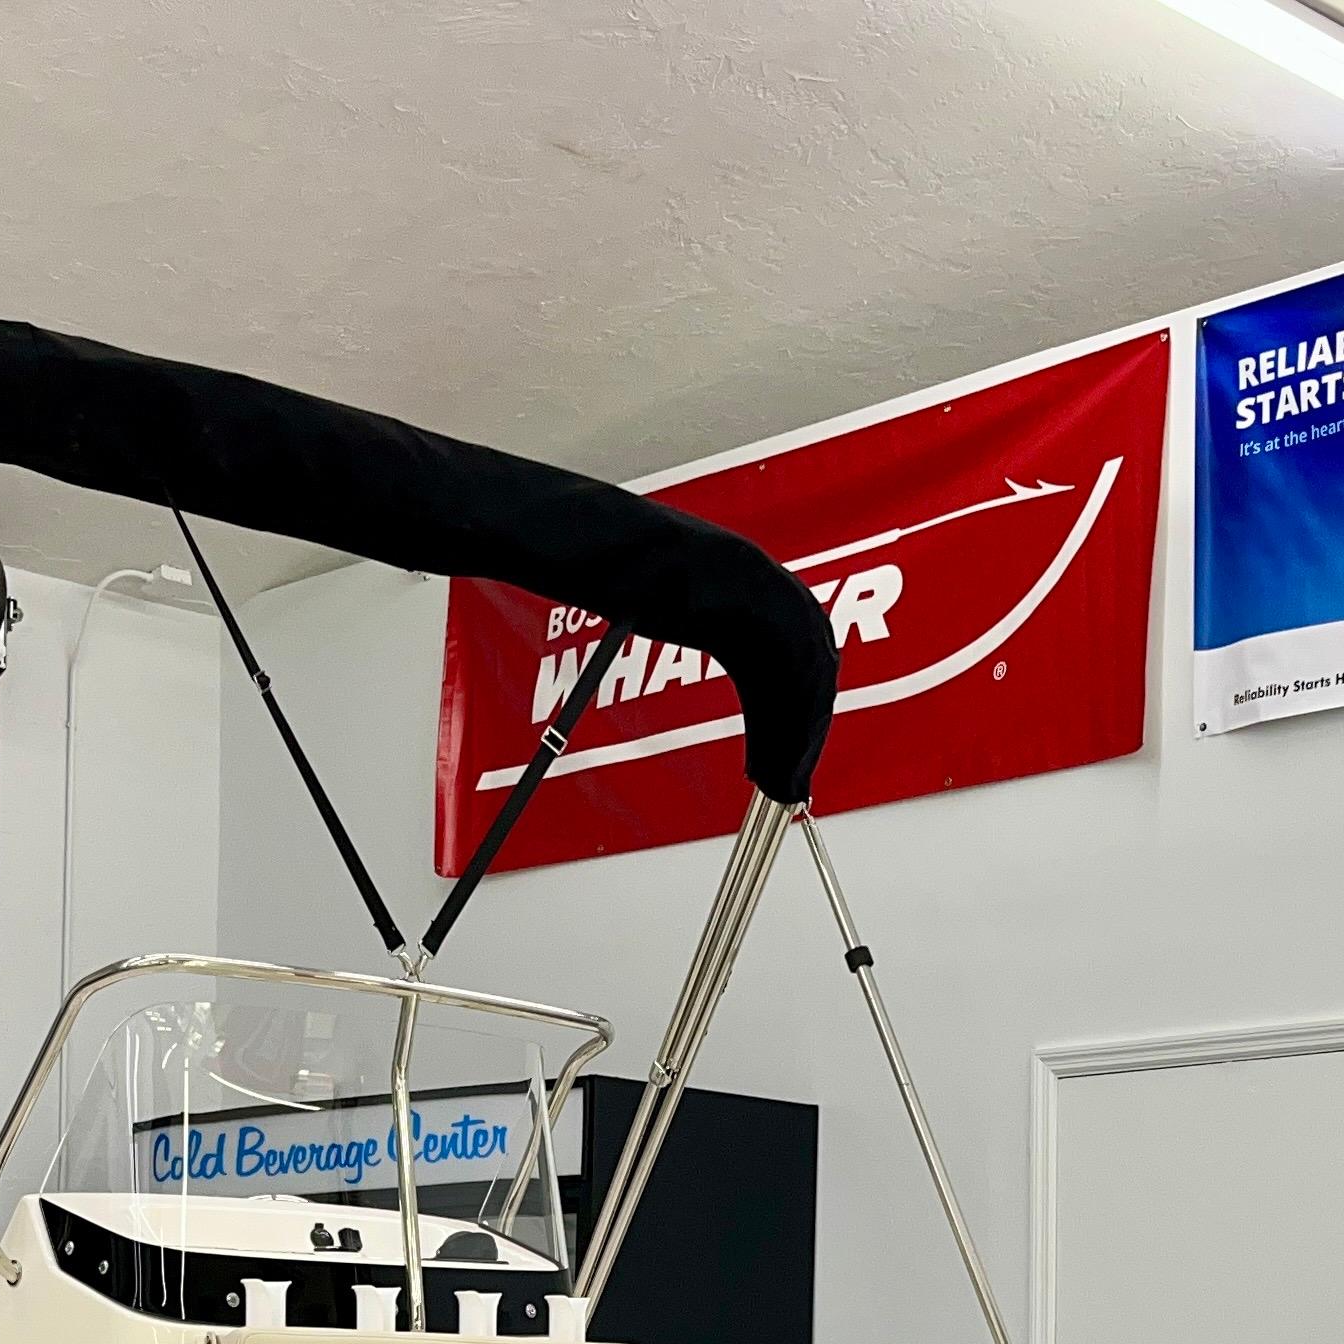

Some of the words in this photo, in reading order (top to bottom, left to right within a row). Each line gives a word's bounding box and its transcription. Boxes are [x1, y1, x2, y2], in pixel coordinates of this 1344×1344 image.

[1239, 440, 1262, 458] It's
[1264, 438, 1281, 453] at
[1284, 429, 1308, 449] the
[1233, 683, 1290, 706] Reliability
[1292, 676, 1331, 693] Starts
[152, 1128, 228, 1183] Cold
[234, 1125, 382, 1185] Beverage
[387, 1108, 509, 1166] Center
